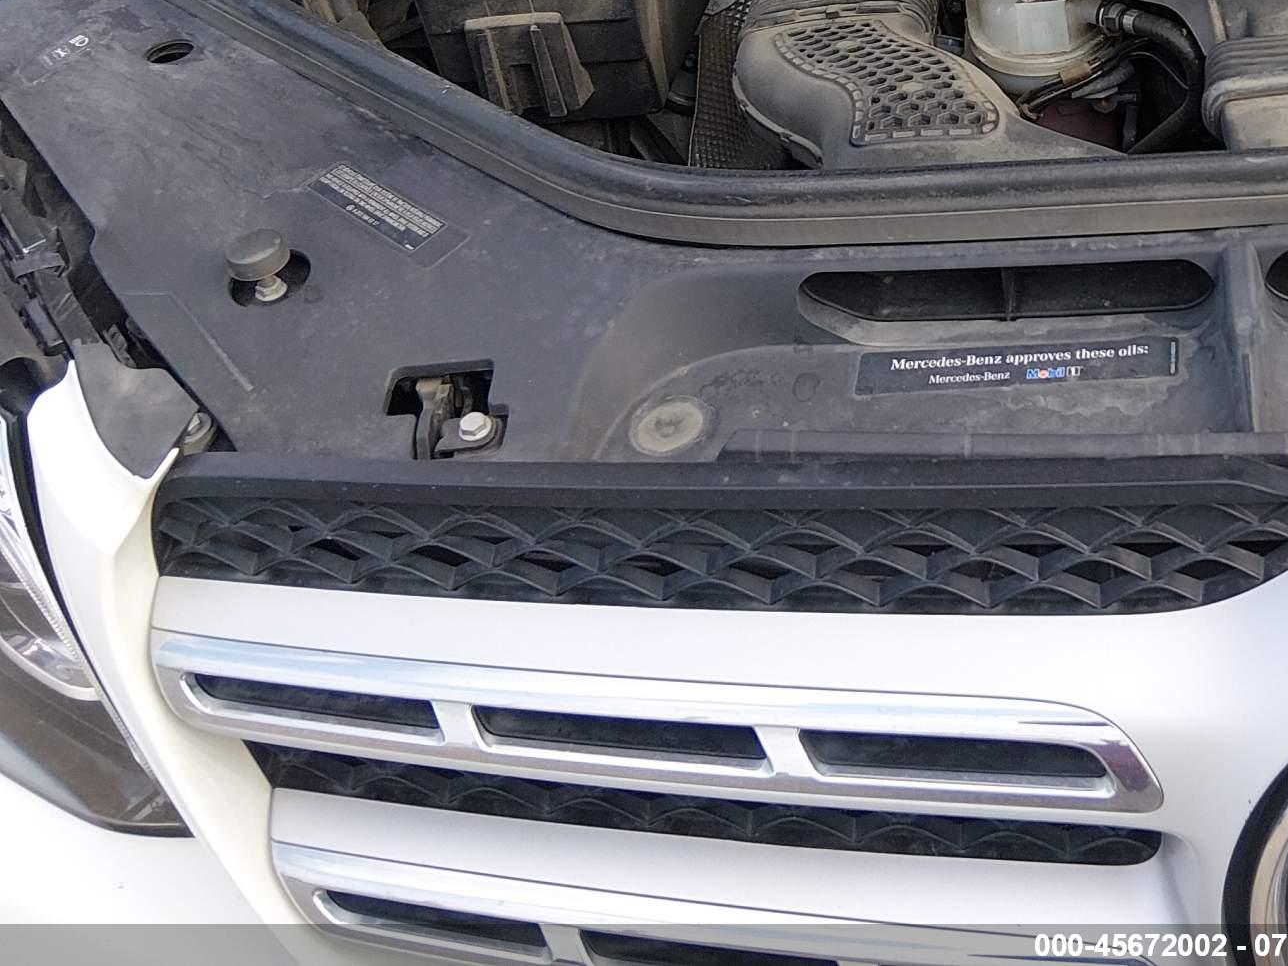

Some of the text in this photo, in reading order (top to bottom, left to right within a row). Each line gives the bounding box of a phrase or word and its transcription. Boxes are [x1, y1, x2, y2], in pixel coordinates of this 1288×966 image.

[890, 344, 1149, 371] Mercedes-Benz approves these oils:
[928, 371, 1010, 384] Mercedes-Benz
[1026, 367, 1065, 379] Mobil
